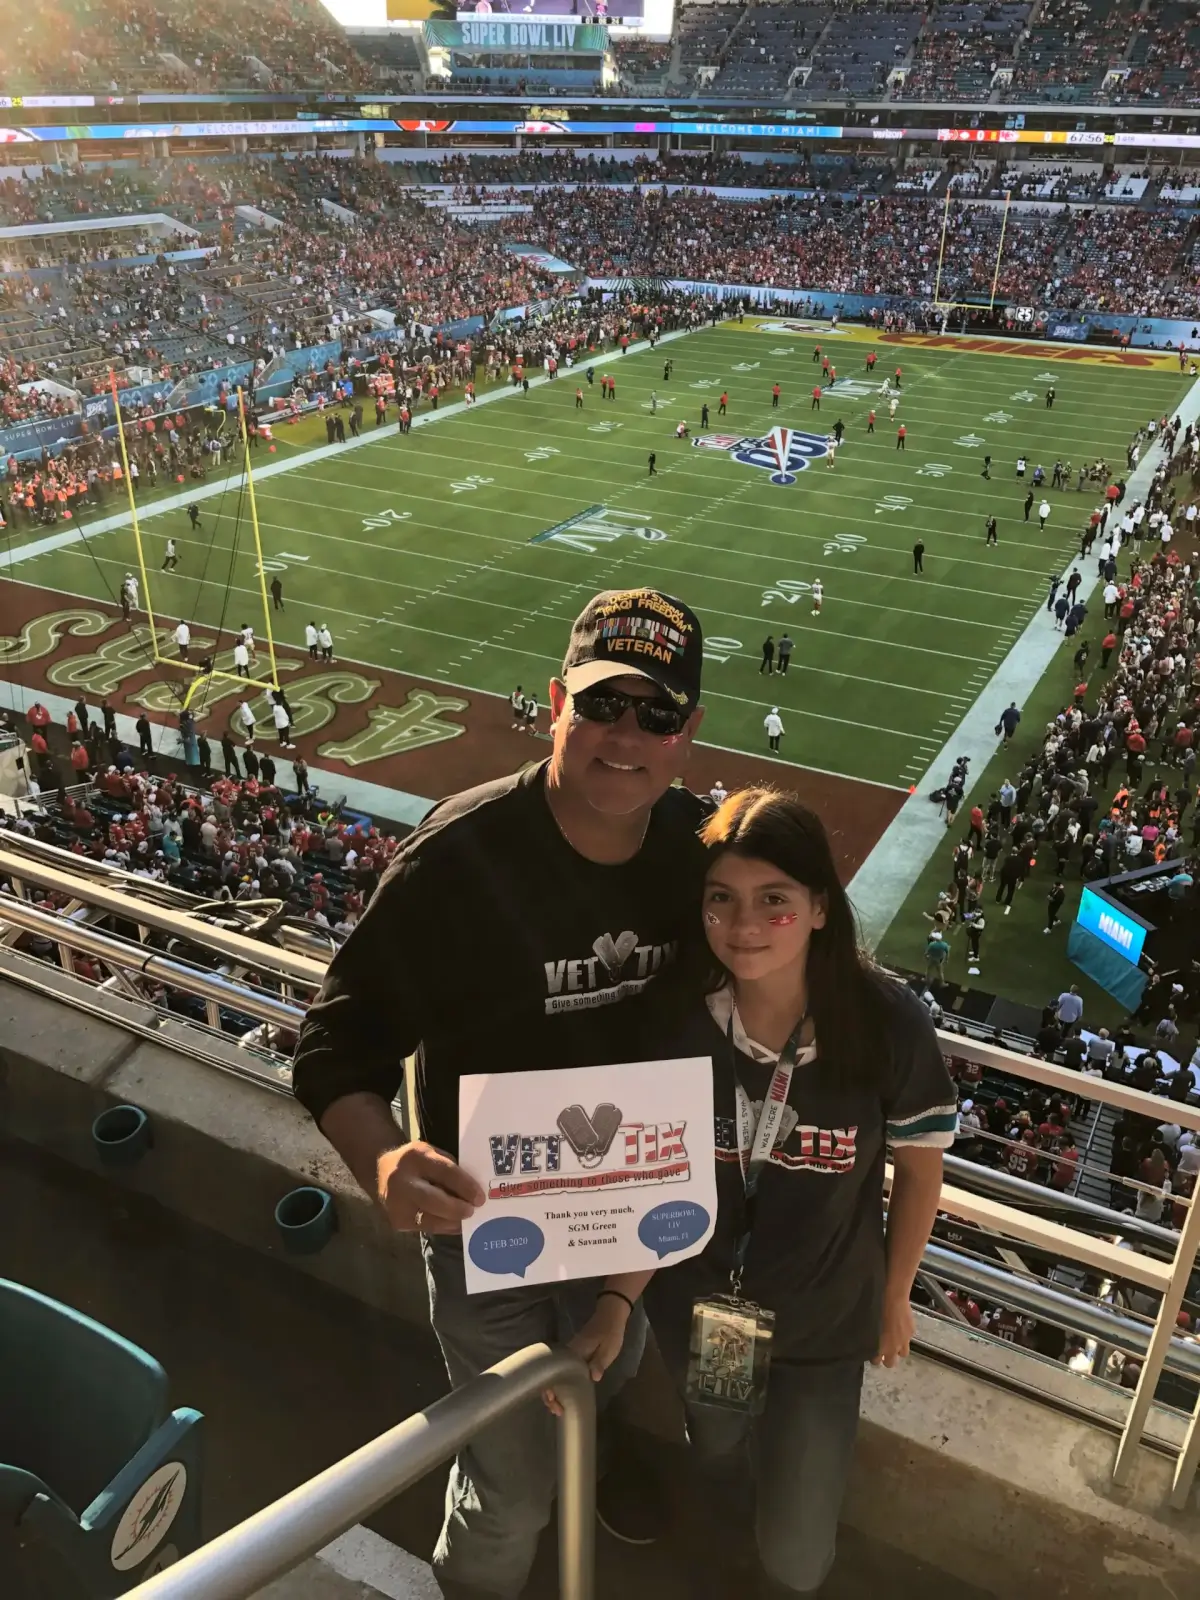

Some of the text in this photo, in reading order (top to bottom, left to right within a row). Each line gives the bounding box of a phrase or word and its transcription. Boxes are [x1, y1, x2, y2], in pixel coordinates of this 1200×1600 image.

[462, 22, 576, 47] SUPER BOWL LIV
[196, 123, 249, 134] WELCOME
[255, 122, 267, 133] TO
[695, 124, 820, 136] WELCOME TO MIAMI
[872, 129, 903, 140] verizon
[1069, 132, 1103, 143] 67:56
[685, 283, 719, 301] SUPER
[1017, 307, 1032, 320] 25
[877, 332, 1171, 366] CHIEFS
[4, 419, 75, 442] SUPER BOWL LIV
[916, 463, 954, 478] 50
[450, 474, 494, 492] 30
[877, 494, 914, 512] 40
[364, 508, 412, 530] 20
[823, 533, 868, 554] 30
[256, 551, 311, 575] 10
[761, 579, 812, 605] 20
[600, 598, 687, 632] IRAQI FREEDOM
[608, 591, 684, 618] DESERT STORM
[606, 638, 673, 664] VETERAN
[702, 636, 743, 663] 10
[1098, 911, 1133, 950] MIAMI
[543, 956, 599, 994] VET
[551, 995, 571, 1010] Give
[573, 990, 616, 1006] something
[965, 1062, 979, 1075] 32
[770, 1070, 790, 1103] MIAMI
[766, 1105, 779, 1129] THERE
[742, 1120, 750, 1148] THERE
[760, 1131, 771, 1148] WAS
[794, 1125, 858, 1158] TIX
[488, 1133, 565, 1176] VET
[617, 1120, 688, 1166] TIX
[1008, 1154, 1028, 1173] 95
[498, 1167, 681, 1193] Give something to those who gave
[544, 1205, 635, 1220] Thank you very much,
[651, 1208, 697, 1221] SUPERBOWL
[568, 1222, 617, 1233] SGM Green
[483, 1236, 529, 1251] 2 FEB 2020
[567, 1236, 618, 1248] & Savannah
